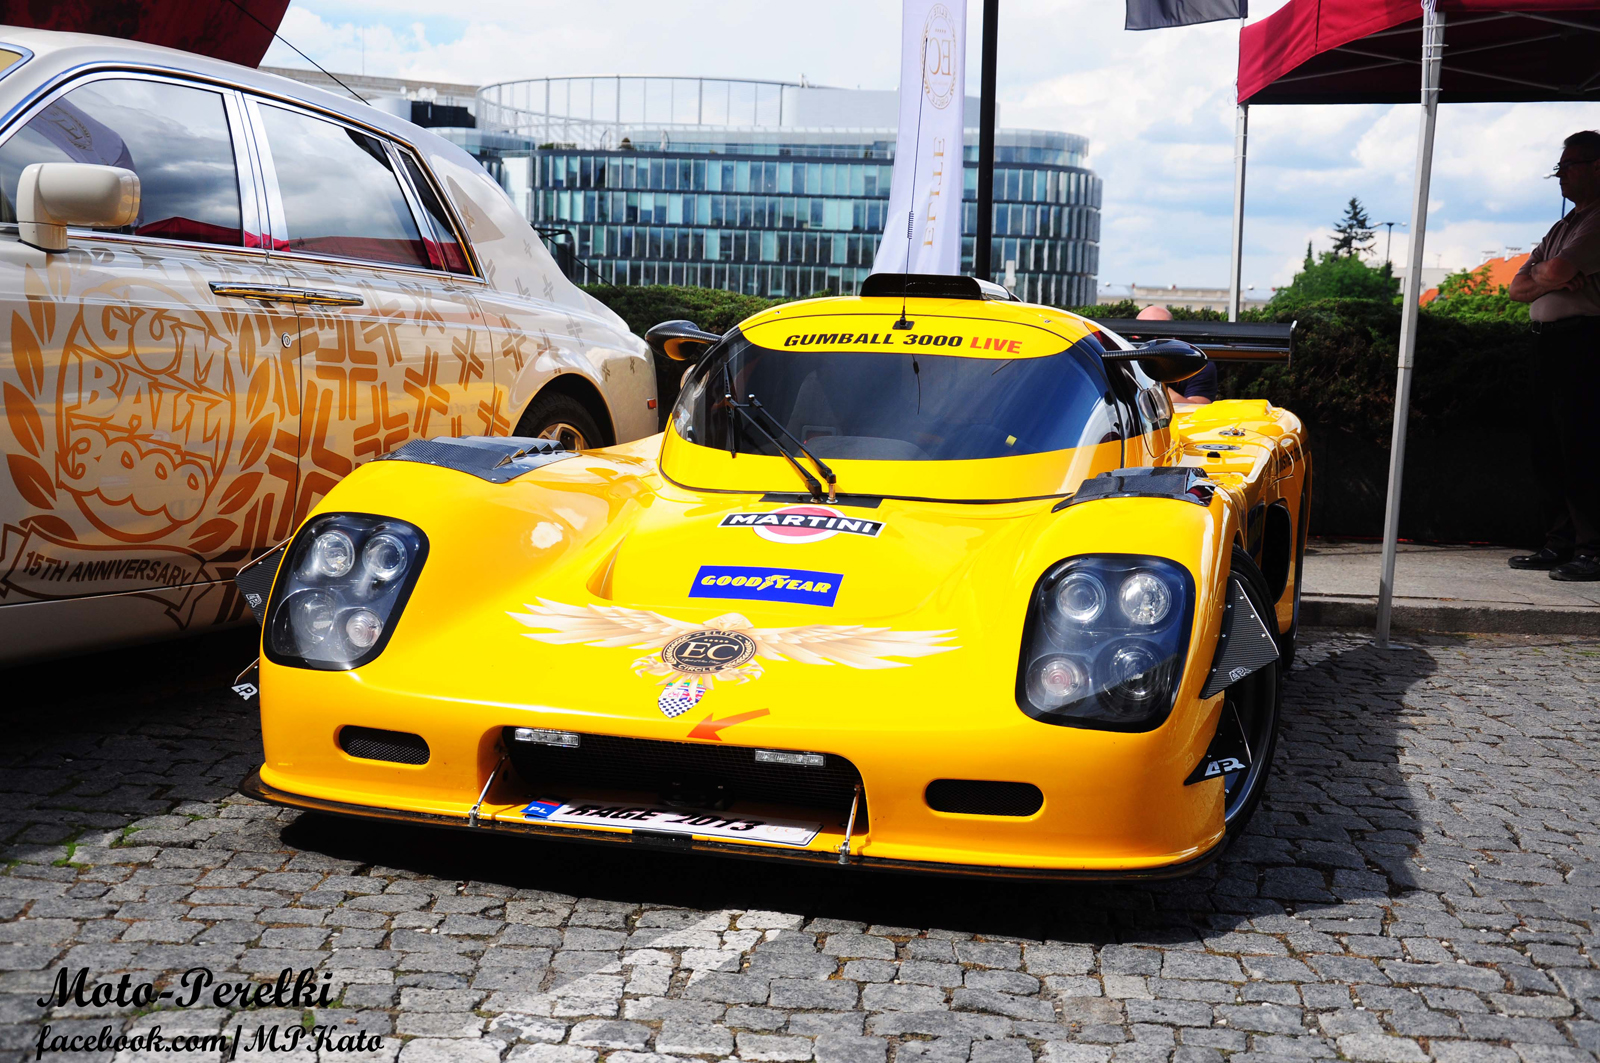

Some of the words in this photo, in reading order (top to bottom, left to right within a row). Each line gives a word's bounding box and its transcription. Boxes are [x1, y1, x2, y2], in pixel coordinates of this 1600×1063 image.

[784, 333, 895, 347] GUMBALL
[903, 333, 963, 347] 3000
[970, 336, 1022, 354] LIVE
[729, 513, 875, 534] MARTINI
[23, 551, 70, 582] 15TH
[67, 559, 192, 590] ANNIVERSARY
[701, 574, 832, 593] GOODYEAR
[678, 641, 739, 661] EC
[528, 806, 548, 814] PL
[564, 804, 662, 820] RAGE
[664, 811, 766, 831] 2013
